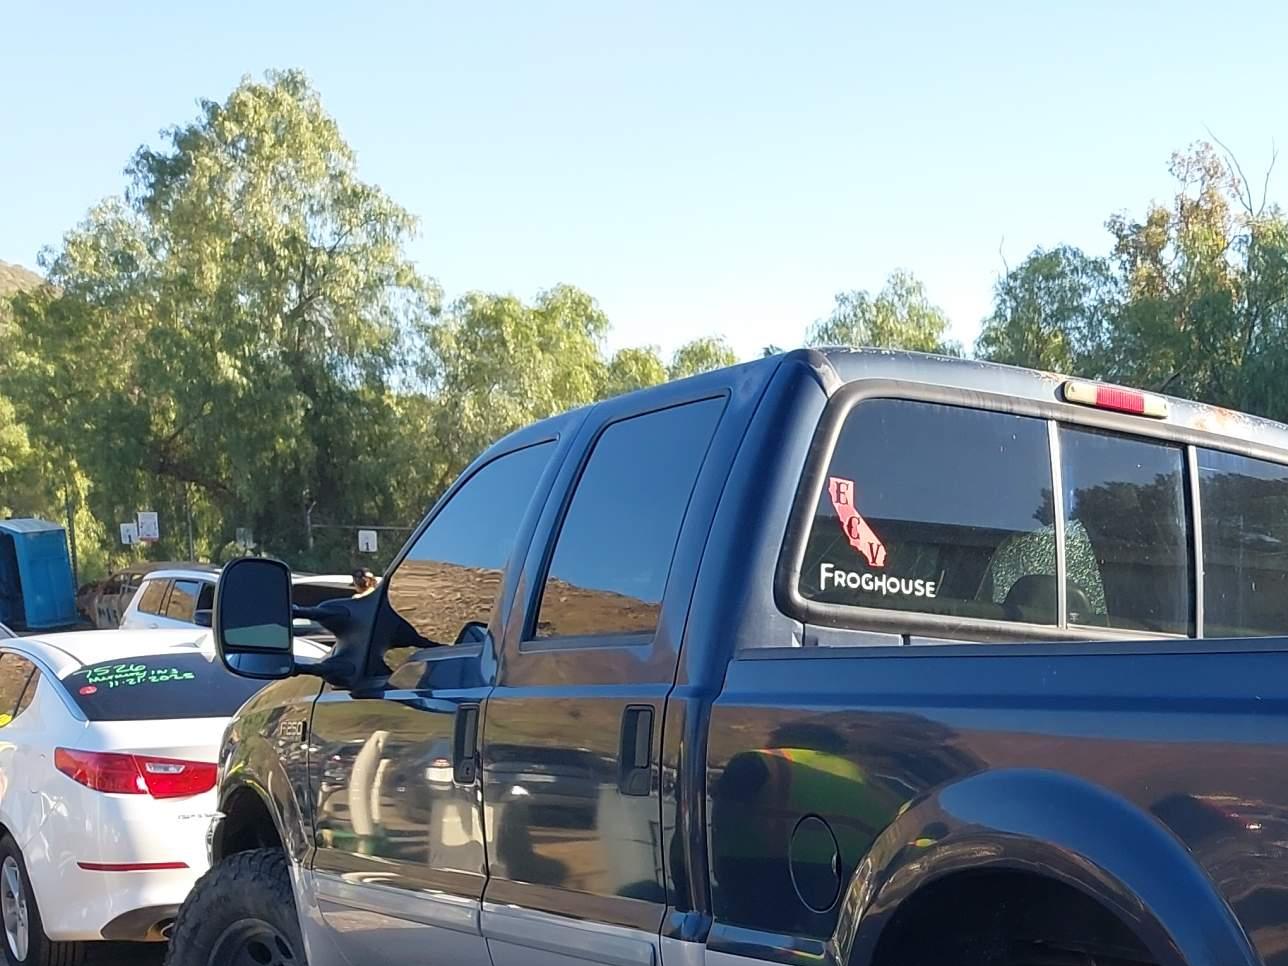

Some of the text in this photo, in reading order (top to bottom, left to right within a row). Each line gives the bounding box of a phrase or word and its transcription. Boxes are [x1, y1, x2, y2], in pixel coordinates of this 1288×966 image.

[834, 481, 880, 565] E C V
[820, 562, 937, 598] FROGHOUSE
